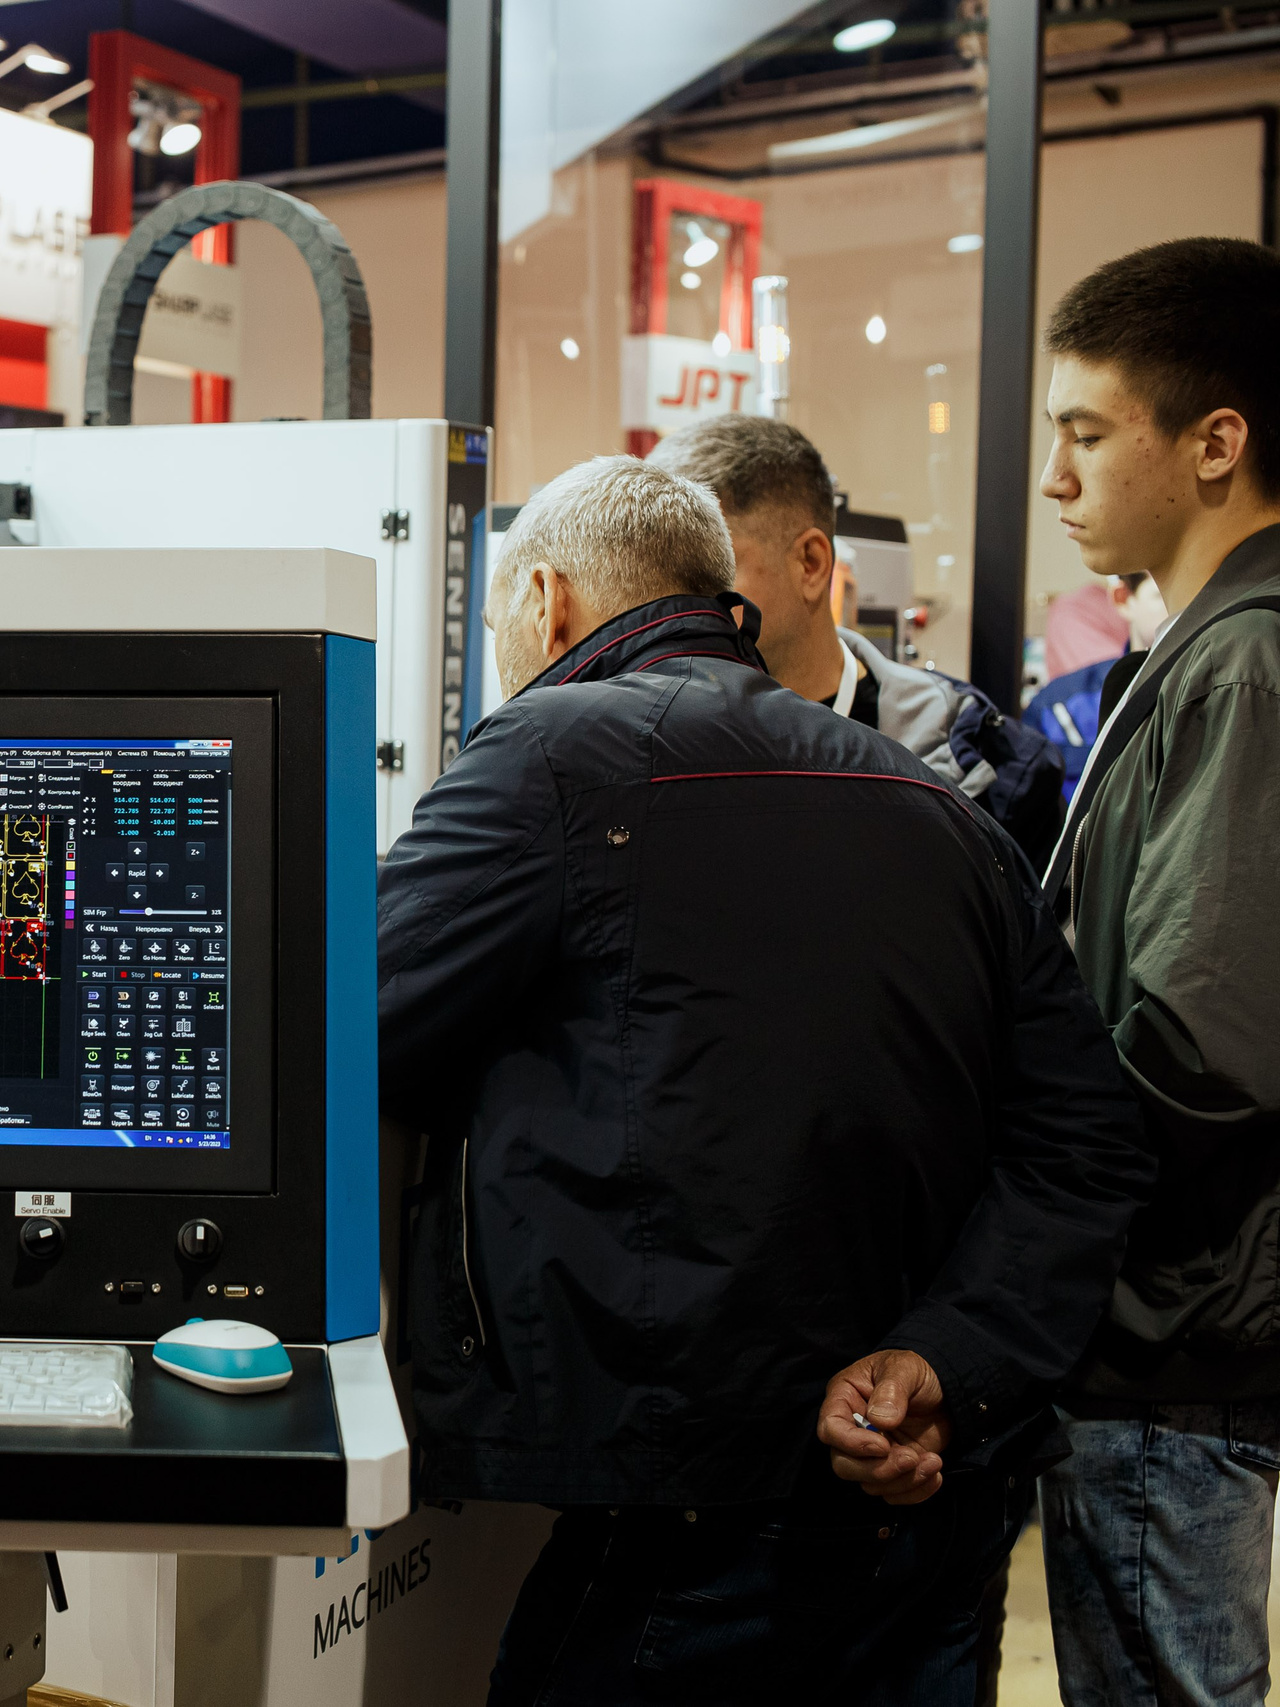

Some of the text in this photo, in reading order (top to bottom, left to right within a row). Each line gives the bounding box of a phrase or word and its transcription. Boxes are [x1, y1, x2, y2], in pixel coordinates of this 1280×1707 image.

[660, 367, 750, 411] JPT
[32, 1195, 55, 1205] 伺服
[314, 1538, 431, 1659] MACHINES
